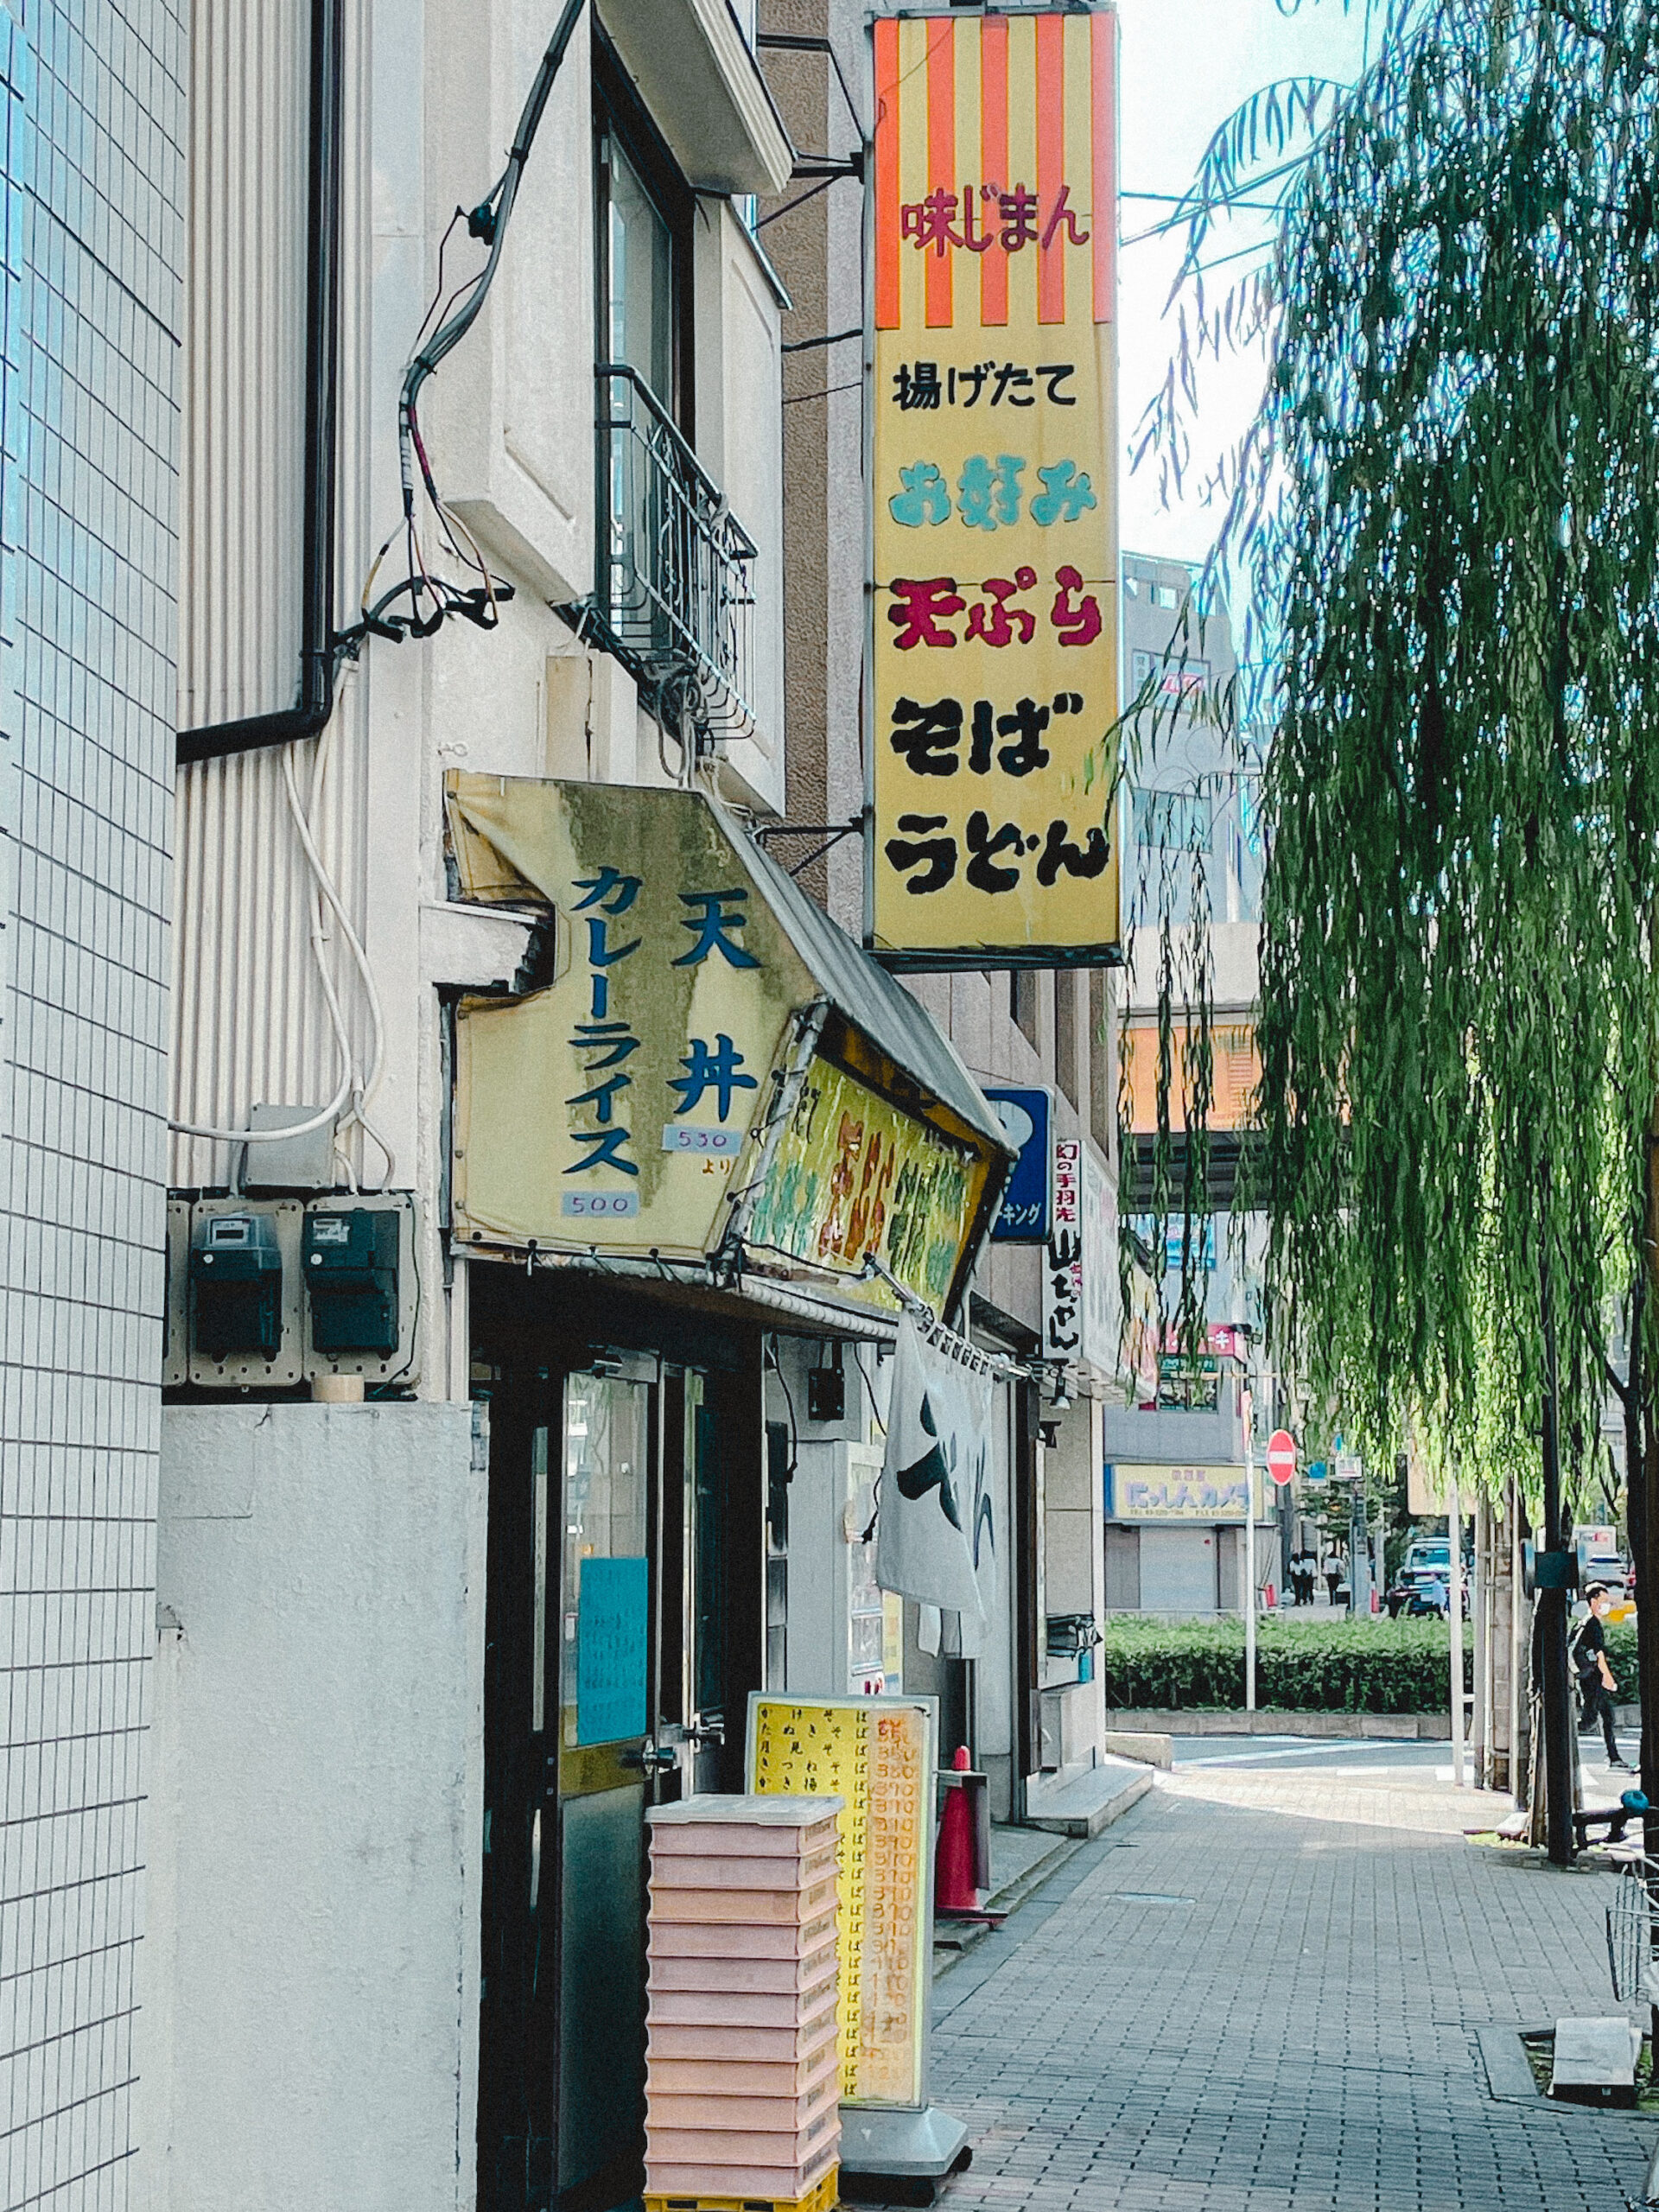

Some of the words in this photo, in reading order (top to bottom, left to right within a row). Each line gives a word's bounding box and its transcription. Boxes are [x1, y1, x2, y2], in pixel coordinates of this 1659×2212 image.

[901, 183, 1090, 257] 味じまん
[893, 361, 1077, 410] 揚げたて
[888, 454, 1097, 531] お好み
[888, 565, 1102, 650] 天ぷら
[890, 692, 1084, 777] そば
[885, 810, 1109, 894] うどん
[563, 866, 643, 1173] カレーライス
[665, 887, 762, 1122] 天丼
[678, 1131, 728, 1147] 530
[702, 1158, 731, 1175] より
[572, 1197, 628, 1213] 500
[1055, 1143, 1077, 1223] 幻の手羽先
[1048, 1228, 1081, 1350] 山ちゃん
